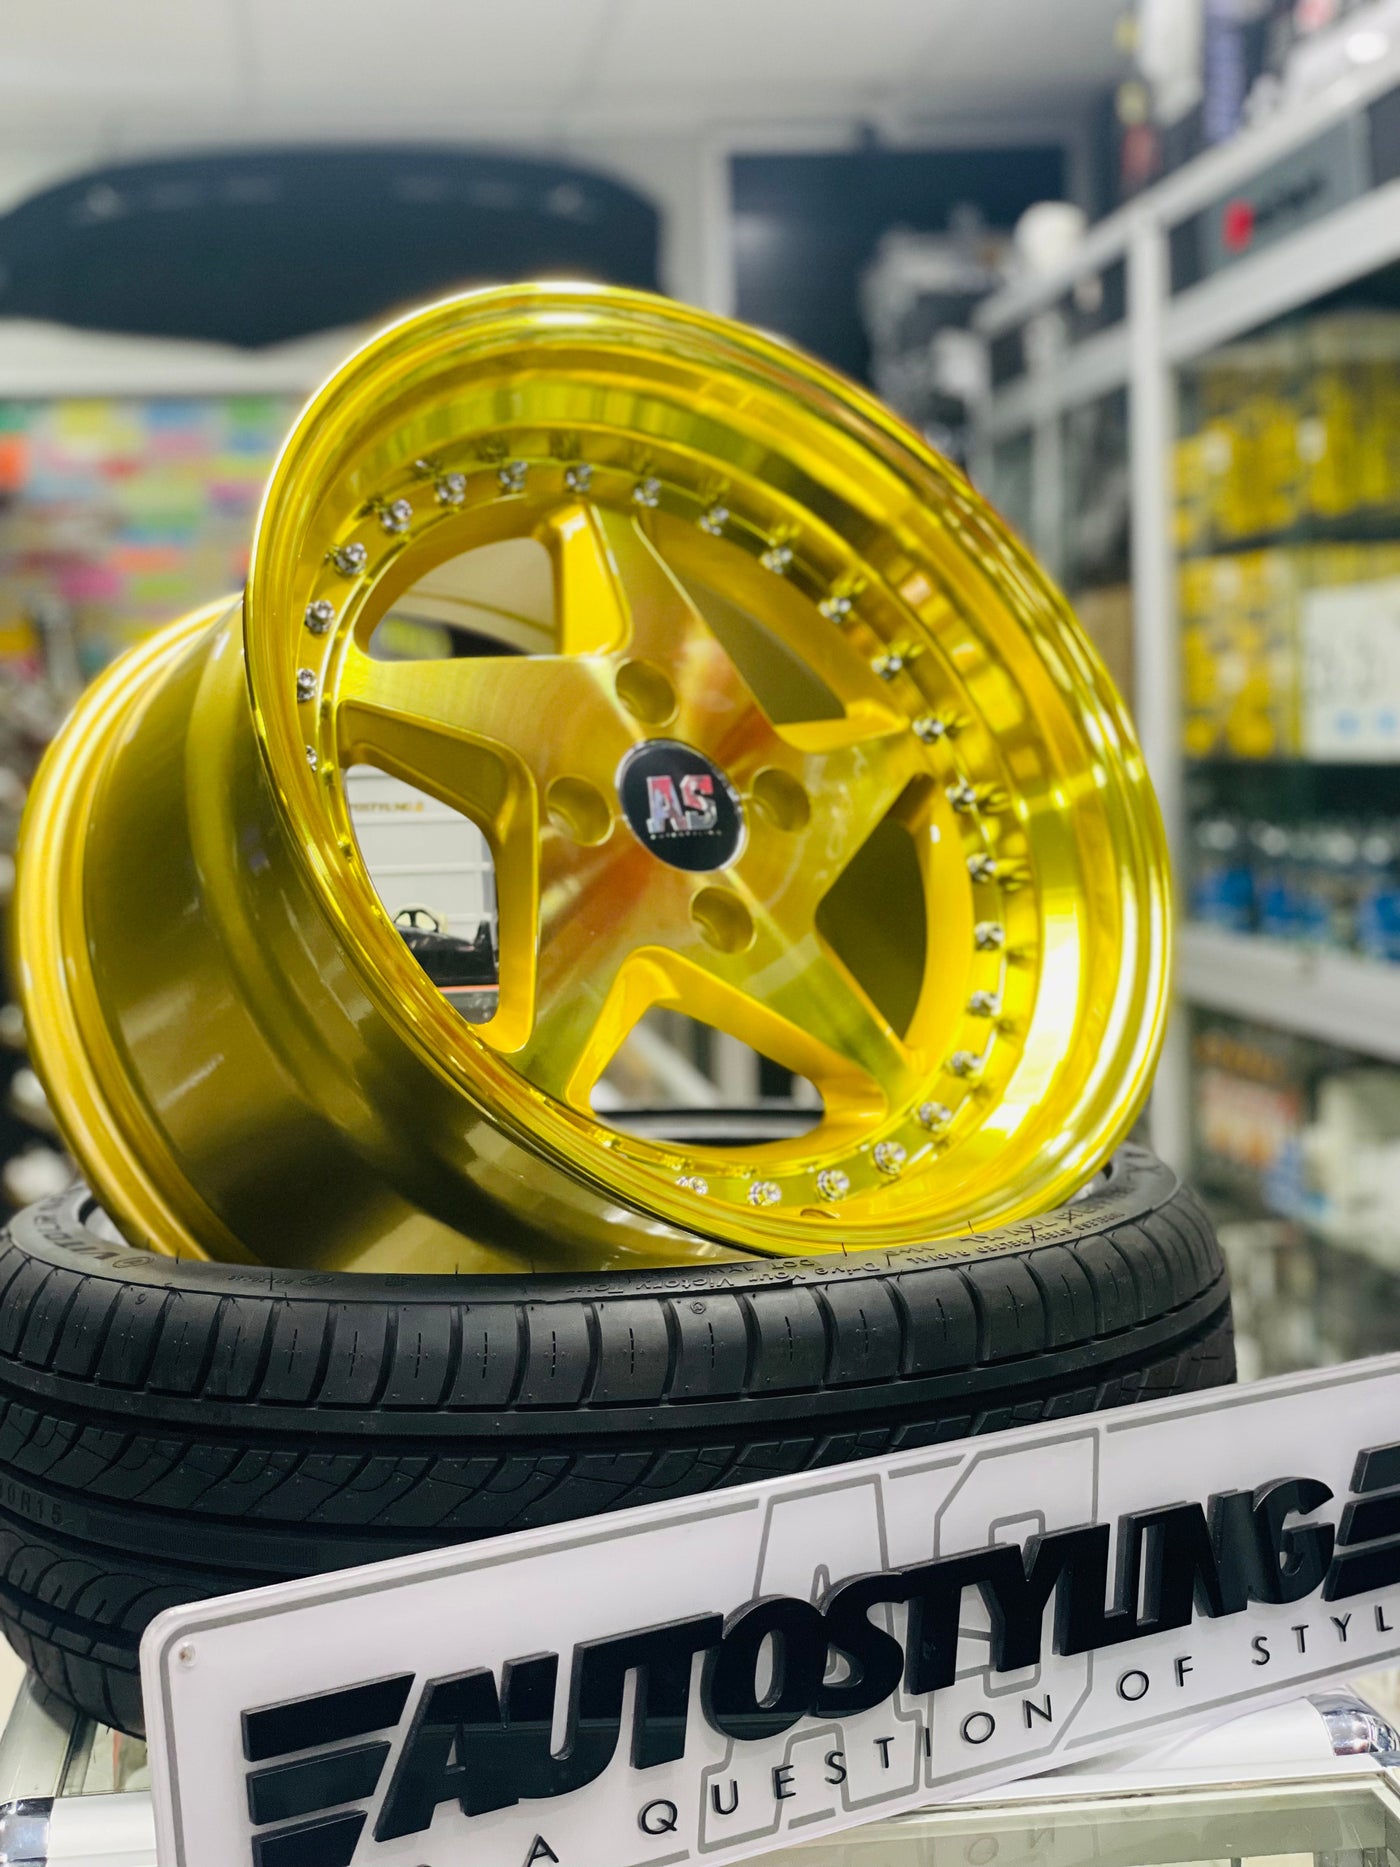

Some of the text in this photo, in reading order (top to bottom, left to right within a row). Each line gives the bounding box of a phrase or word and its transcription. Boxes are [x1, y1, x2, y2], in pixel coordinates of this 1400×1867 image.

[645, 773, 719, 834] AS
[565, 1262, 881, 1295] Drive Your Victory Tour
[771, 1258, 816, 1271] DOT
[905, 1249, 971, 1265] RADIAL
[371, 1476, 1335, 1843] AUTOSTYLING
[521, 1604, 1394, 1867] A QUESTION OF STYL
